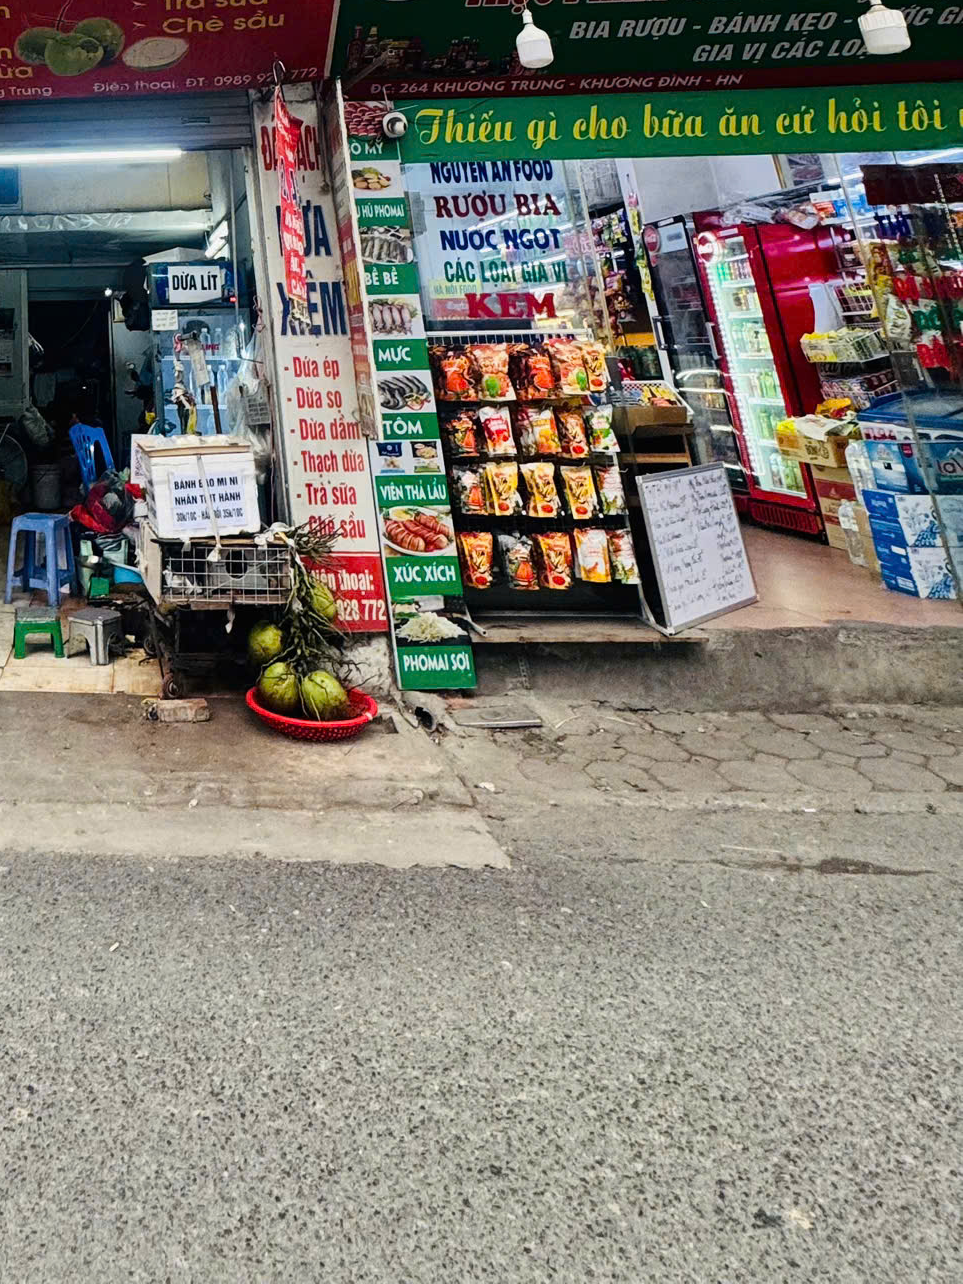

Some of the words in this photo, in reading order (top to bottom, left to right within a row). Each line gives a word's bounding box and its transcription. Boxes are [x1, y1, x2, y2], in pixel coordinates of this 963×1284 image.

[162, 15, 224, 34] Chè
[233, 10, 285, 31] sầu
[569, 19, 610, 40] BIA
[617, 16, 687, 41] RƯỢU
[708, 11, 782, 35] BÁNH
[784, 12, 838, 35] KẸO
[693, 43, 734, 62] GIA
[741, 42, 767, 64] VỊ
[771, 38, 822, 60] CÁC
[214, 74, 252, 87] 0989
[290, 67, 319, 80] 772
[400, 82, 429, 94] 264
[433, 79, 505, 93] KHƯƠNG
[511, 78, 565, 92] TRUNG
[579, 76, 654, 90] KHƯƠNG
[658, 72, 703, 88] ĐÌNH
[716, 74, 743, 86] HN
[9, 86, 53, 97] Trung
[414, 106, 516, 145] Thiếu
[526, 110, 562, 149] gì
[572, 104, 631, 142] cho
[643, 102, 706, 139] bữa
[719, 106, 765, 137] ăn
[776, 105, 817, 135] cứ
[828, 97, 887, 133] hỏi
[897, 99, 948, 132] tôi
[491, 161, 512, 182] AN
[514, 160, 554, 182] FOOD
[375, 203, 405, 217] PHOMAI
[433, 190, 507, 222] RƯỢU
[513, 192, 562, 216] BIA
[503, 228, 562, 254] NGỌT
[172, 271, 197, 291] DỪA
[200, 271, 218, 291] LÍT
[444, 257, 477, 283] CÁC
[521, 261, 550, 283] GIA
[464, 292, 558, 319] KEM
[378, 345, 412, 364] MỰC
[323, 356, 340, 380] ép
[296, 386, 323, 409] Dừa
[299, 417, 326, 440] Dừa
[383, 416, 423, 435] TÔM
[301, 449, 338, 478] Thạch
[342, 449, 365, 473] dừa
[174, 479, 196, 490] BÁNH
[217, 477, 227, 486] MI
[230, 476, 239, 485] NI
[305, 482, 328, 505] Trà
[332, 482, 357, 505] sữa
[380, 481, 404, 501] VIÊN
[404, 479, 426, 500] THẢ
[218, 491, 242, 502] HÀNH
[341, 511, 366, 539] sầu
[393, 562, 422, 583] XÚC
[423, 561, 457, 582] XÍCH
[362, 599, 387, 620] 772
[403, 653, 449, 672] PHOMAI
[450, 651, 471, 673] SỢI
